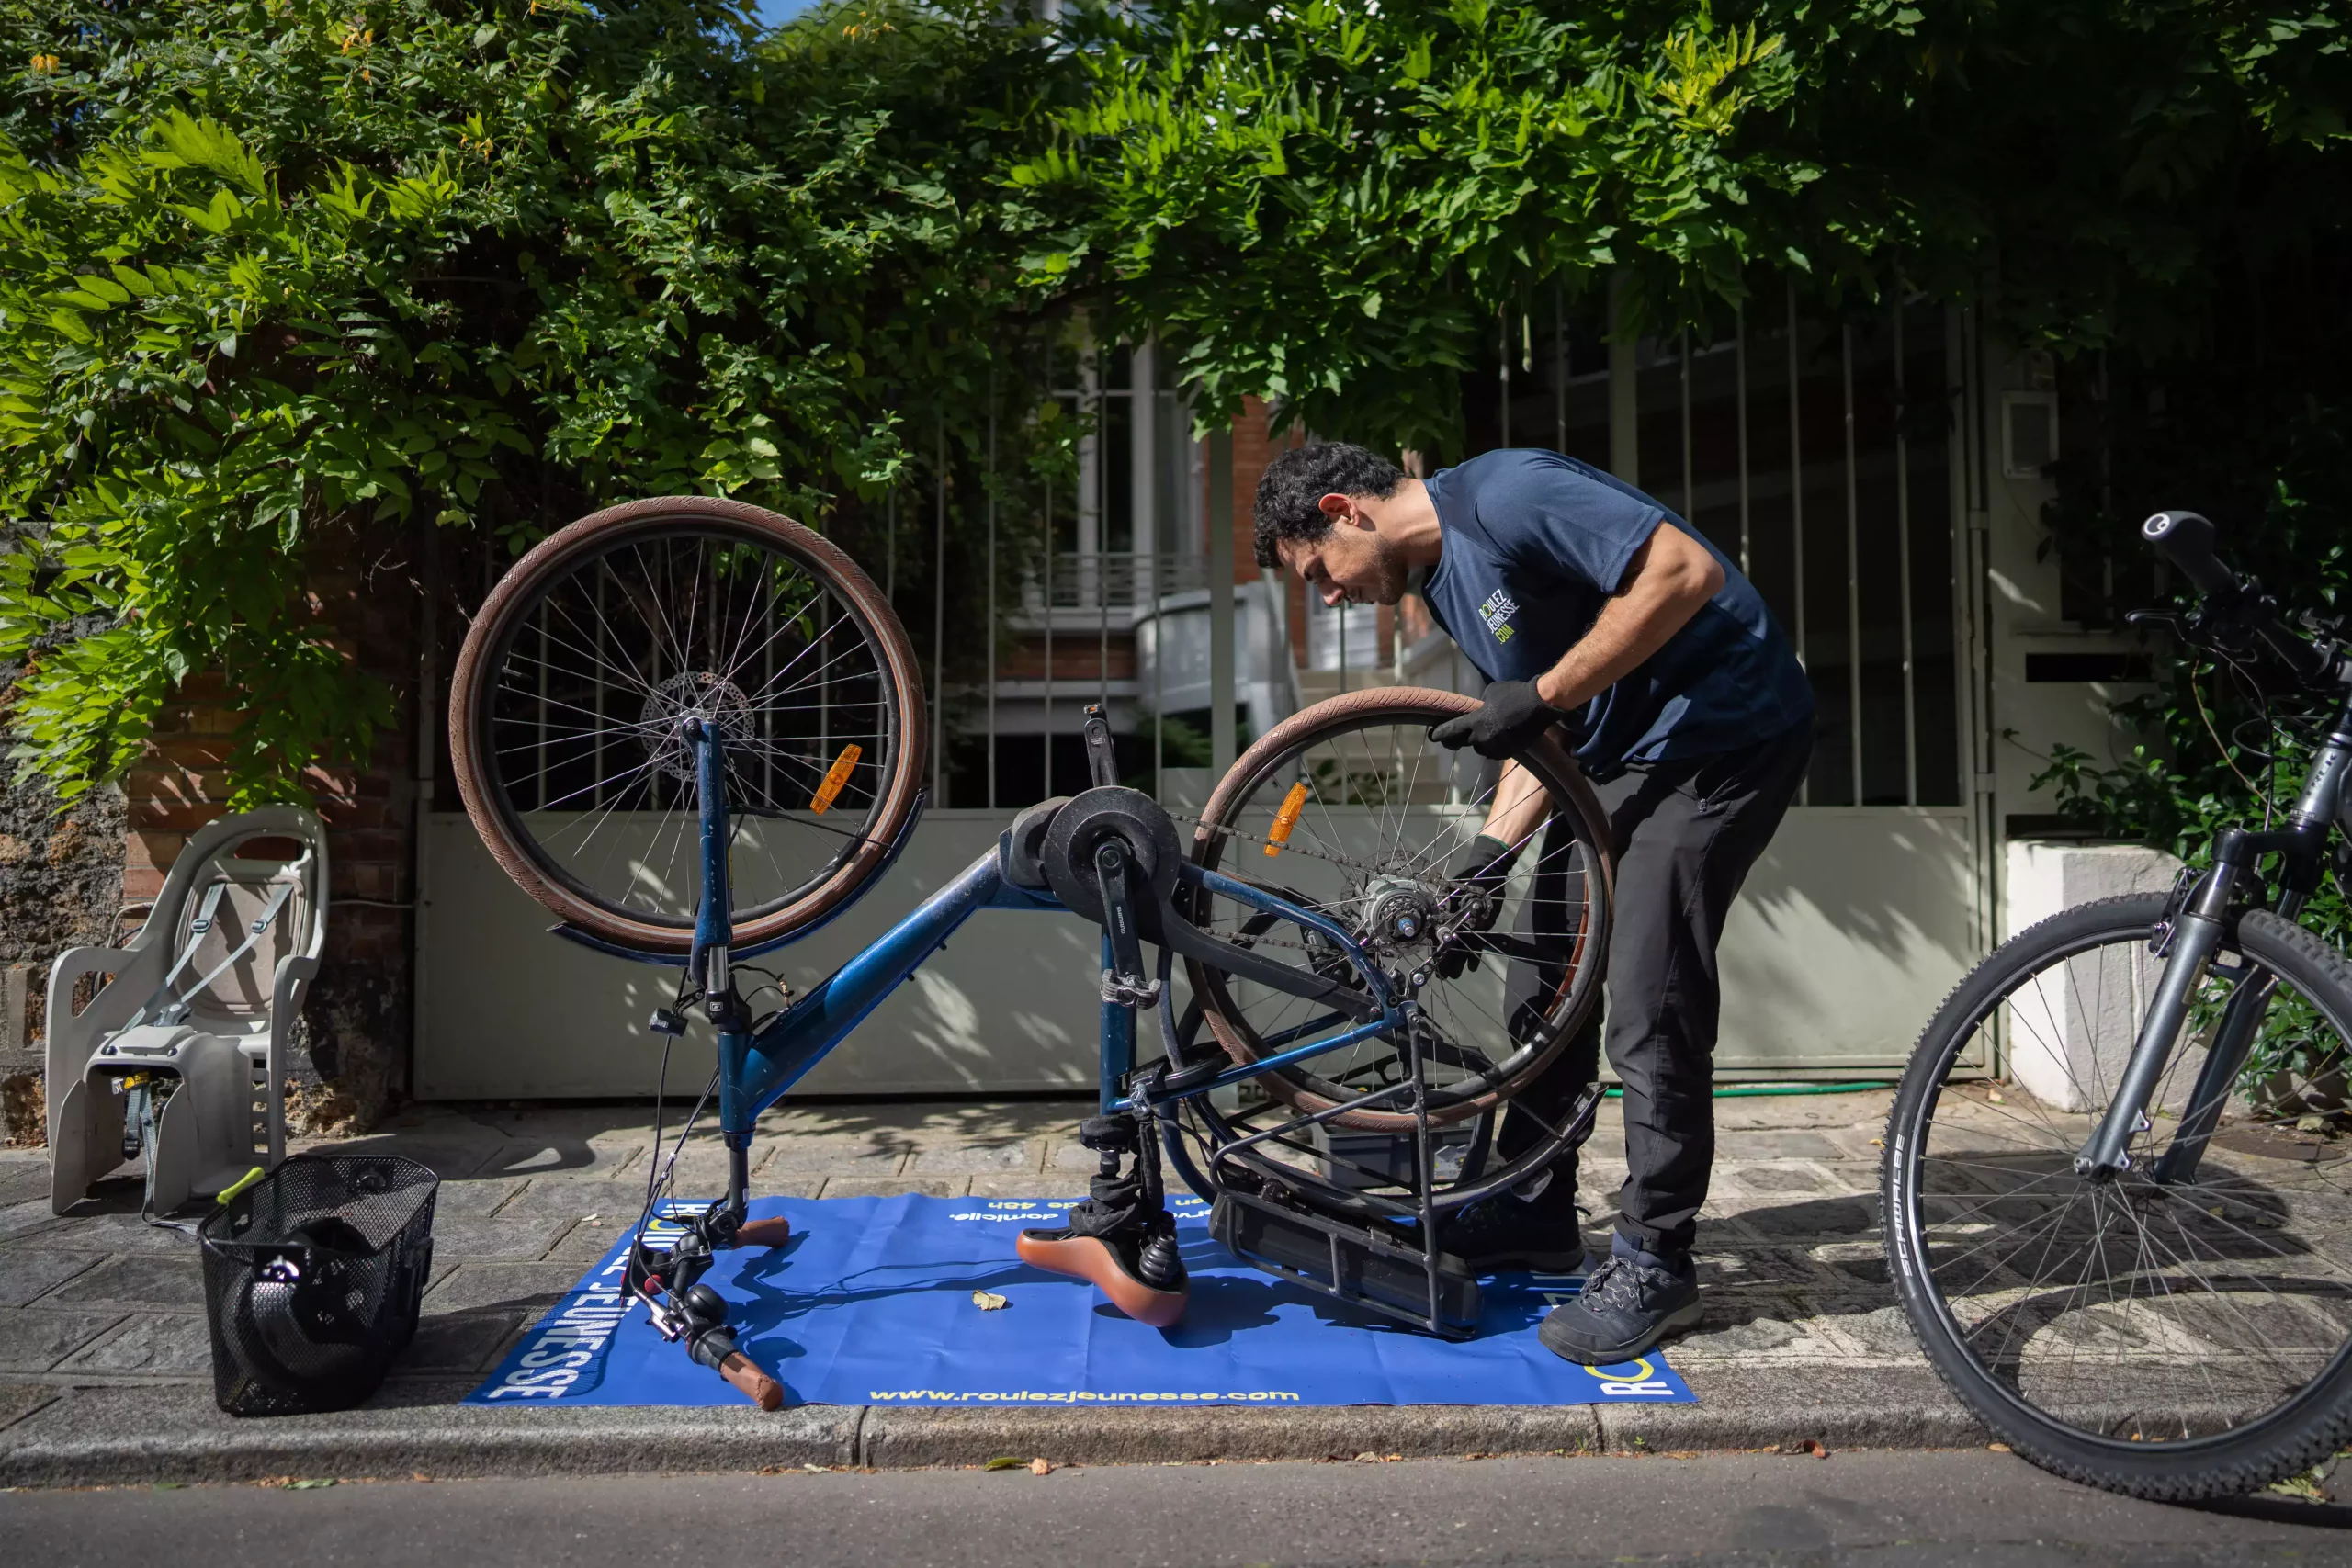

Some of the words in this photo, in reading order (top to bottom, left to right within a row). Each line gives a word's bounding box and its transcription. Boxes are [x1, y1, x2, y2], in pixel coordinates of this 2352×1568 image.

[1478, 589, 1507, 621] ROULEZ
[1487, 599, 1520, 634] JEUNESSE
[1495, 624, 1515, 644] .COM
[1116, 906, 1126, 934] SHIMANO
[949, 1213, 1059, 1223] domicile.
[1893, 1134, 1913, 1277] SCHWALBE
[488, 1282, 639, 1398] JEUNESSE
[870, 1390, 1300, 1404] www.roulezjeunesse.com
